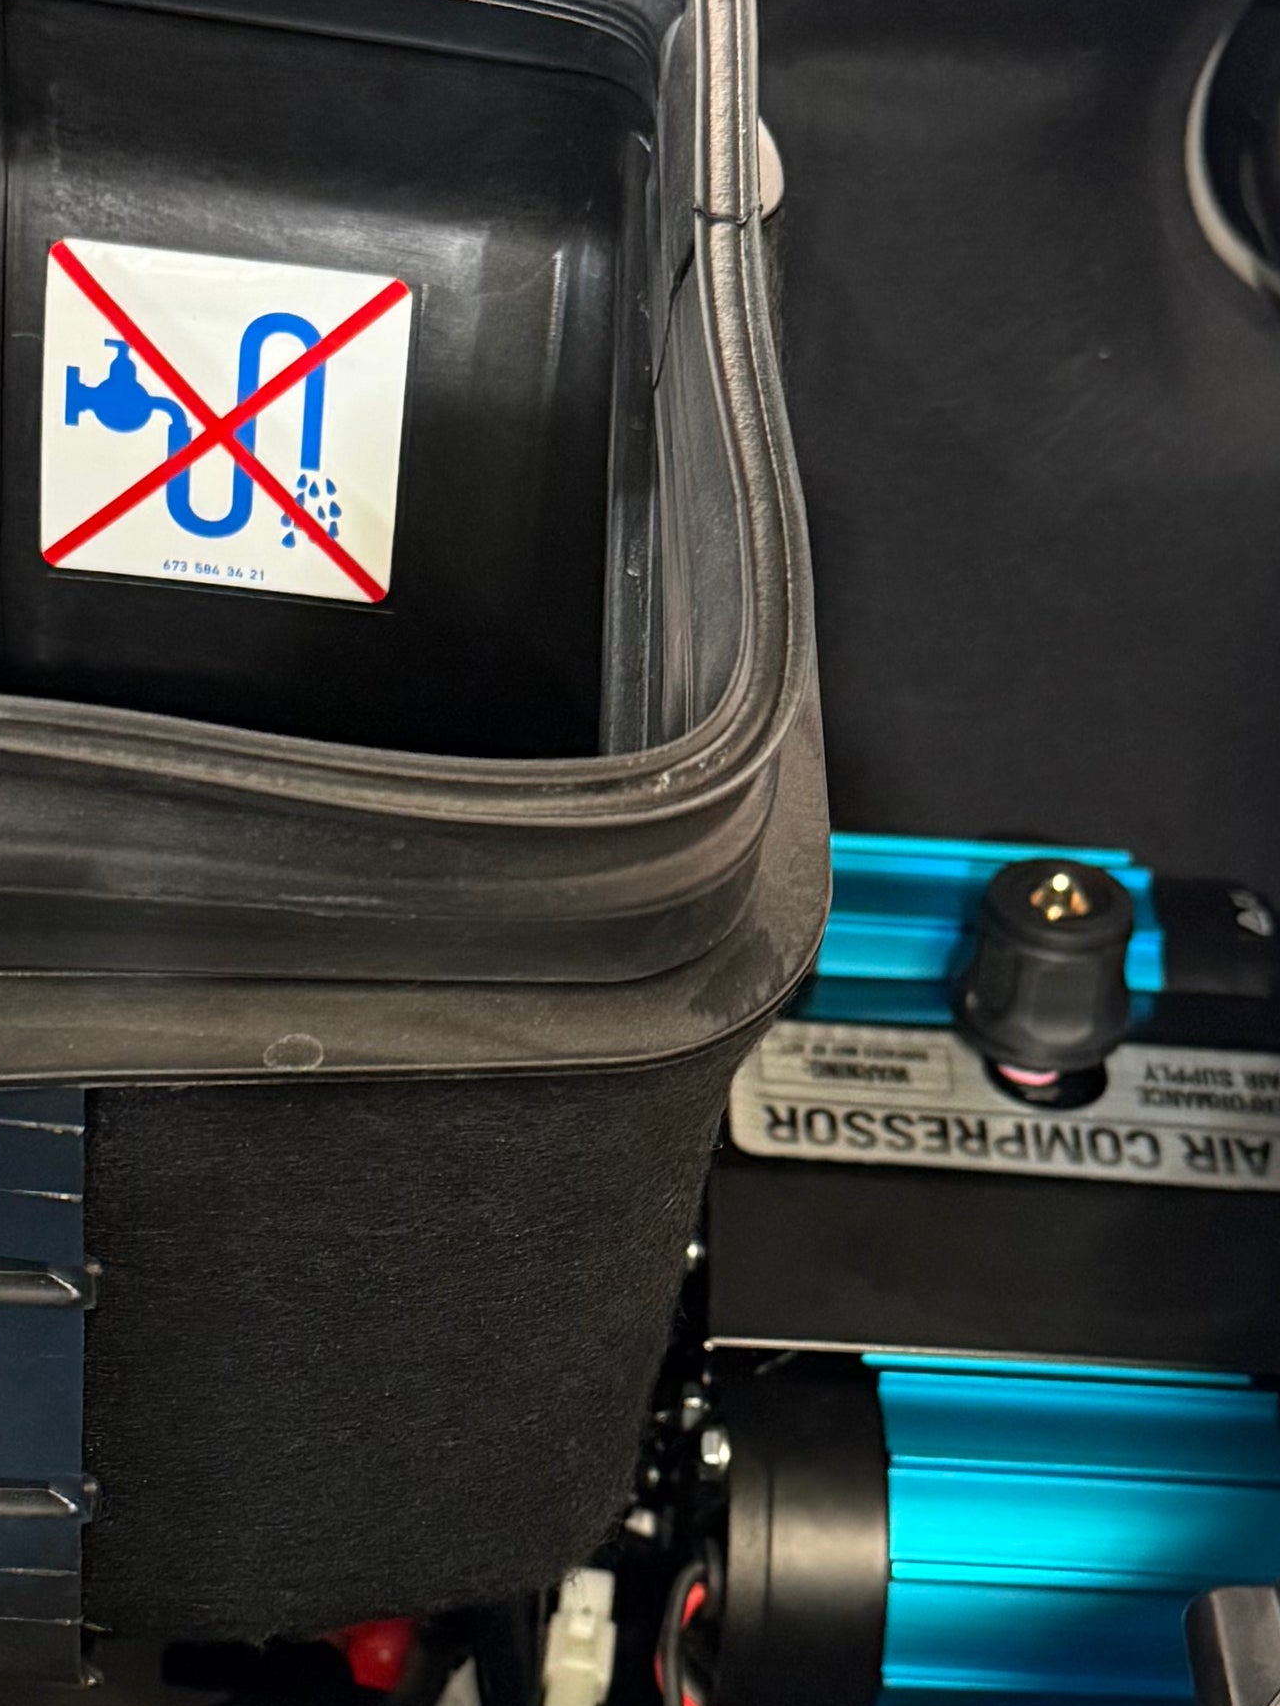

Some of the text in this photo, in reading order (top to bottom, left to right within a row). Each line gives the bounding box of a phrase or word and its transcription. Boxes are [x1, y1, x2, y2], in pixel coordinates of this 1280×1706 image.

[162, 559, 188, 573] 673
[195, 563, 219, 577] 584
[249, 568, 265, 582] 21
[763, 1103, 1163, 1171] COMPRESSOR
[1183, 1133, 1273, 1179] AIR
